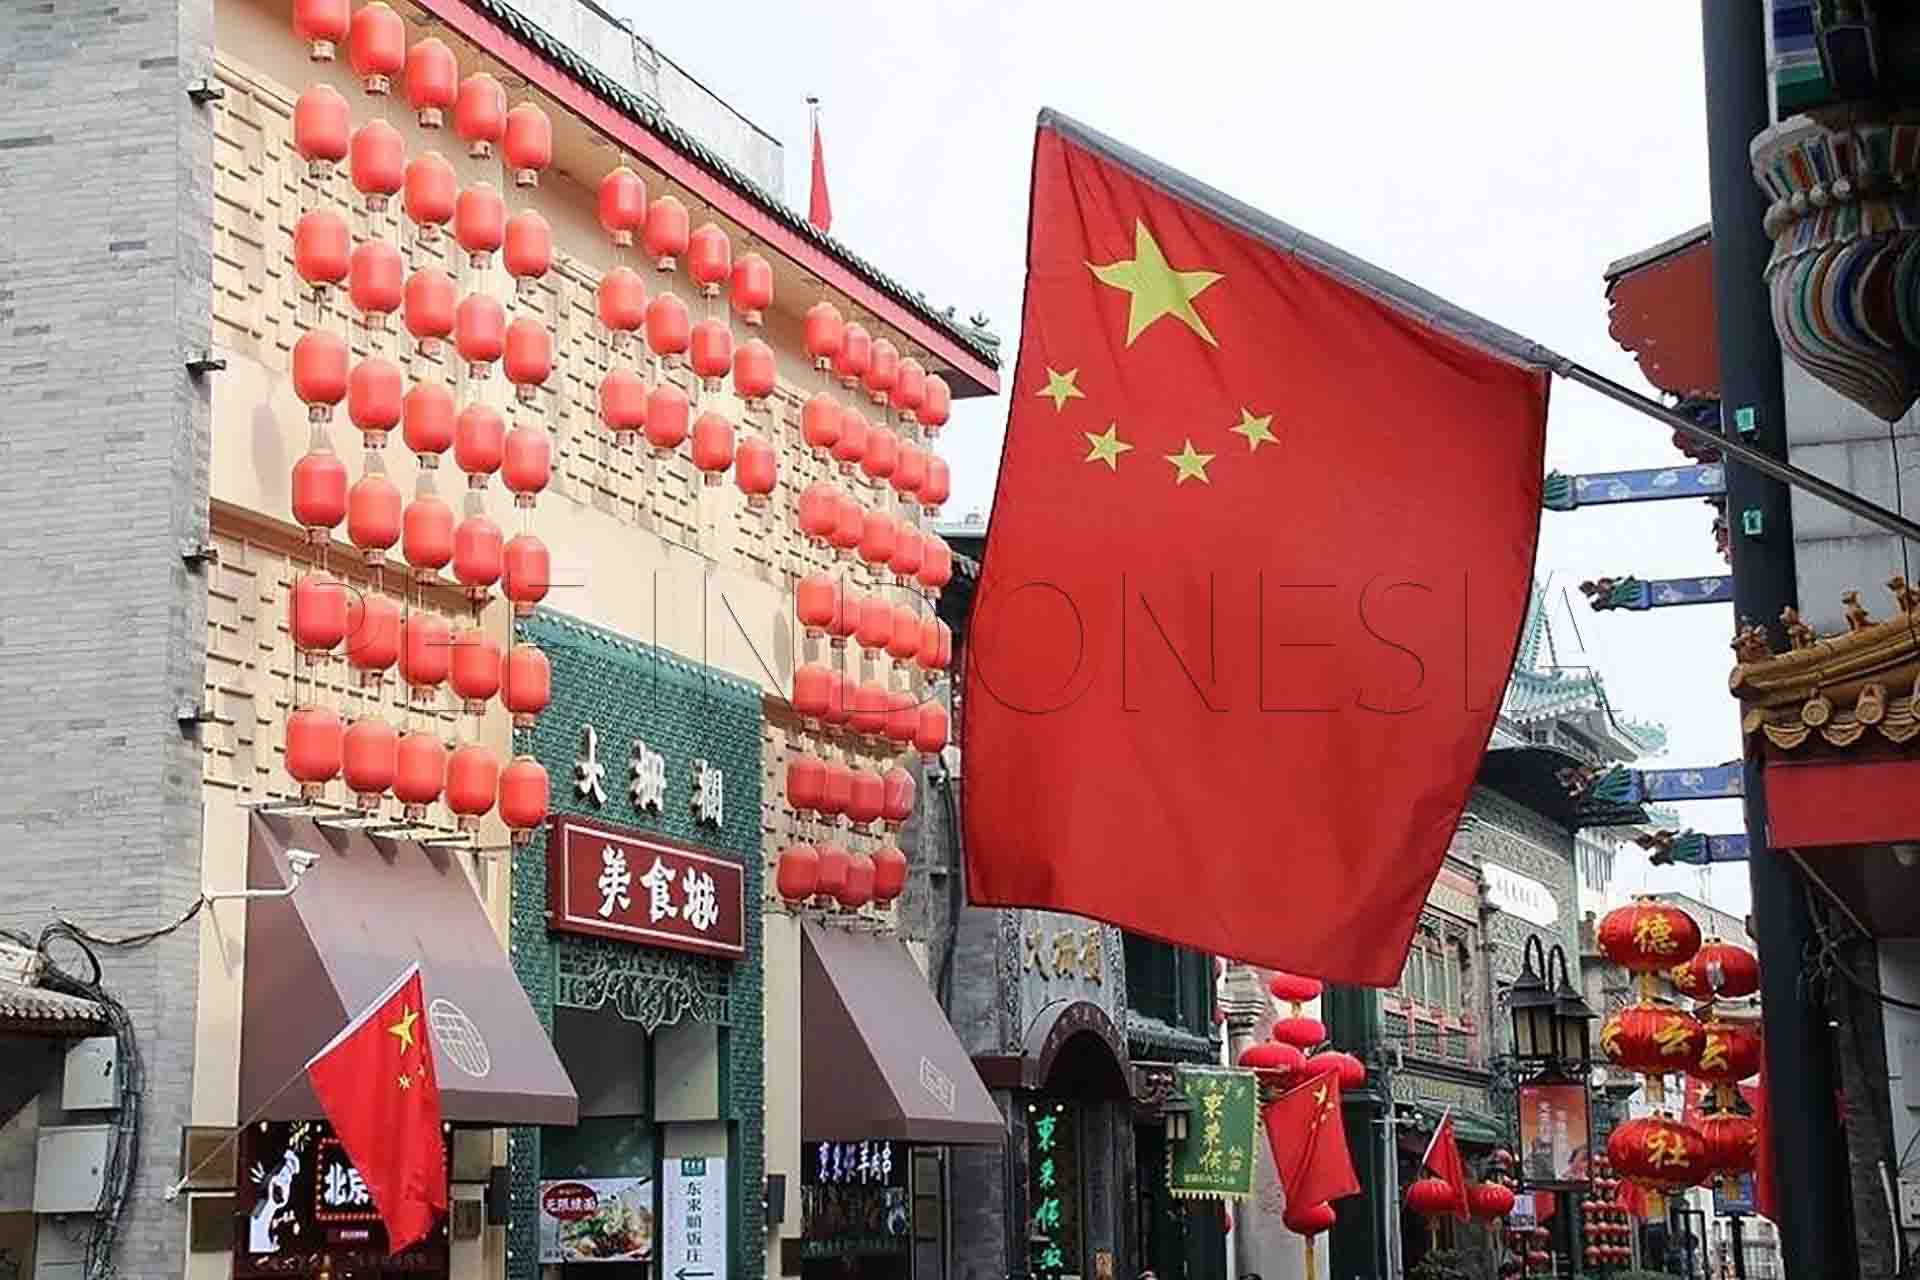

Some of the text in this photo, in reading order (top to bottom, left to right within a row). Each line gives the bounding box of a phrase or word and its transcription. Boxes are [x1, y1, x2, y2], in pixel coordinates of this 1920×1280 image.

[598, 842, 719, 931] 美食城
[1647, 1130, 1690, 1168] 社
